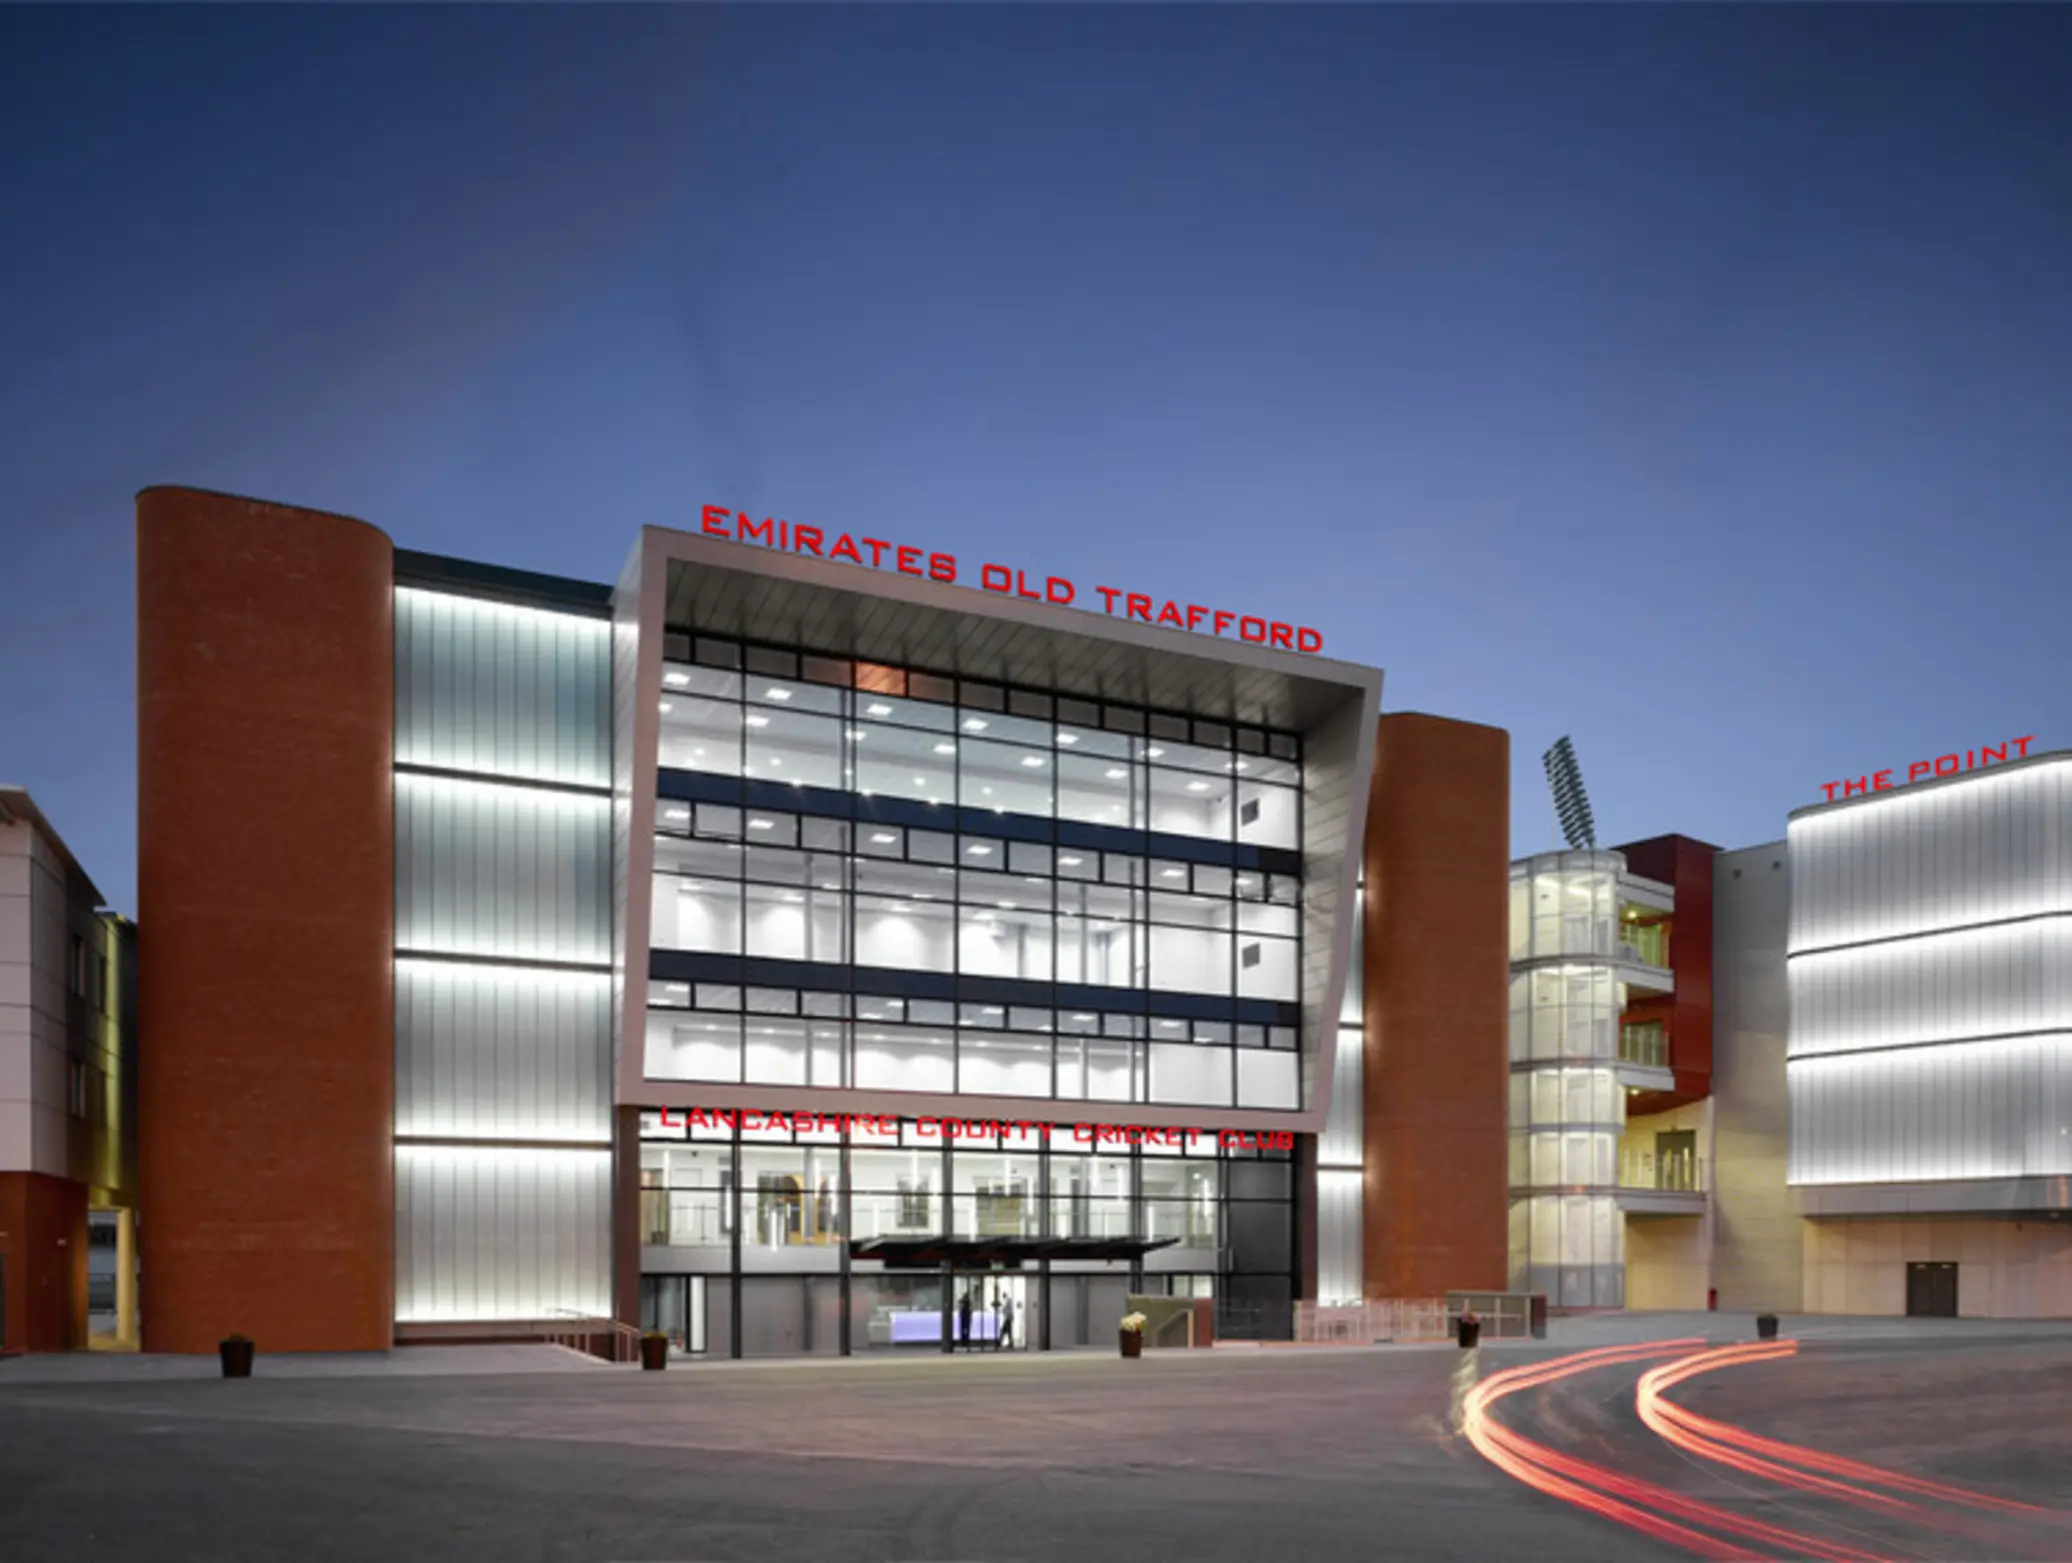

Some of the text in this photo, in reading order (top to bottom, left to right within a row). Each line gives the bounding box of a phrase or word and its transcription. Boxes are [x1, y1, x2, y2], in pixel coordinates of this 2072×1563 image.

[701, 504, 1323, 653] EMIRATES OLD TRAFFORD
[1820, 735, 2035, 803] THE POINT
[660, 1104, 1294, 1150] LANCASHIRE COUNTY CRICKET CLUB
